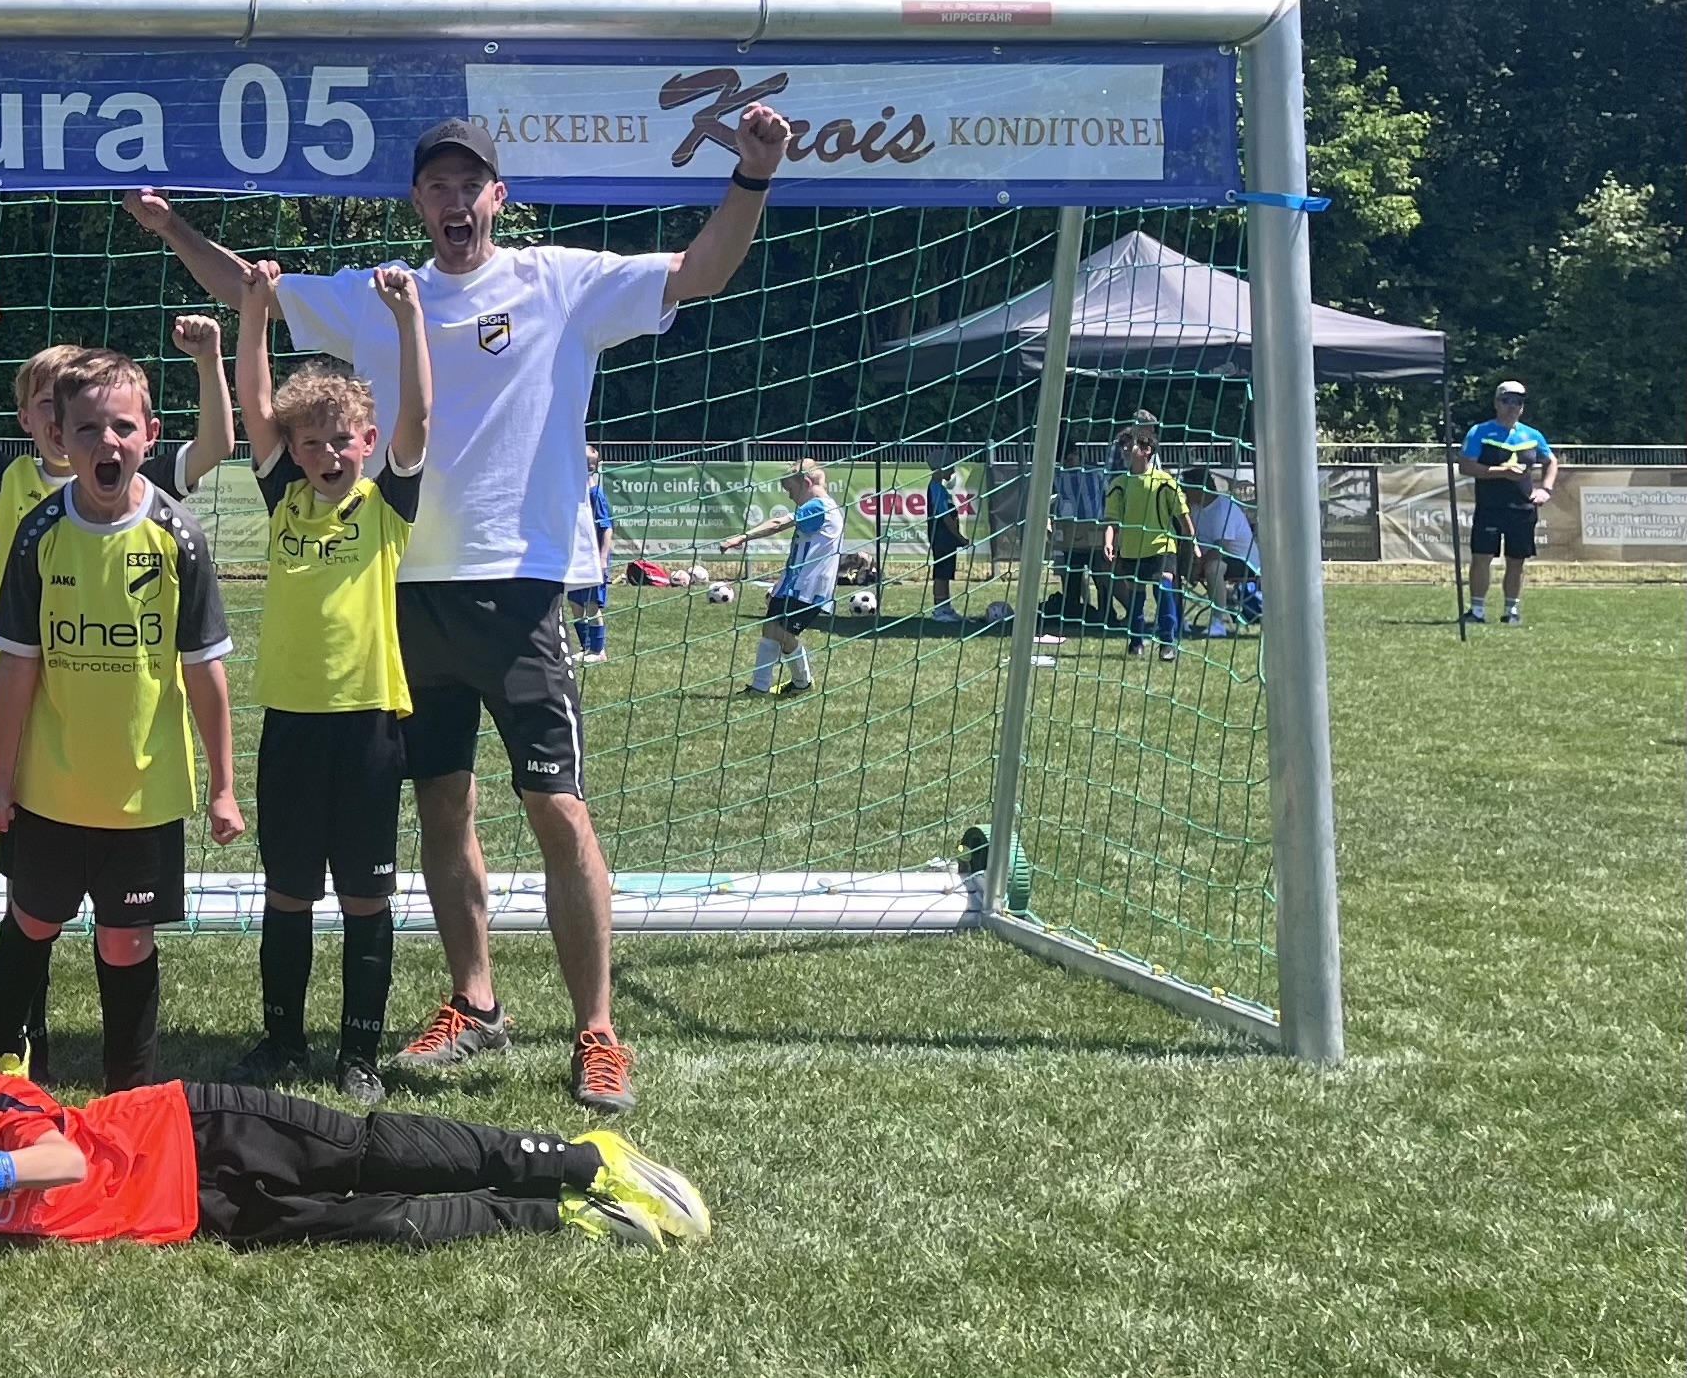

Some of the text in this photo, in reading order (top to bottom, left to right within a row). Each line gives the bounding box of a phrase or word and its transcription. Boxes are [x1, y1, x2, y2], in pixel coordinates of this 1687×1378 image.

[941, 13, 1012, 22] KIPPGEFAHR
[219, 63, 375, 176] 05
[948, 116, 1165, 147] KONDITOREI
[479, 315, 508, 325] SGH
[612, 478, 658, 494] Strom
[663, 477, 721, 494] einfach
[859, 492, 976, 515] enex
[128, 554, 160, 566] SGH
[50, 575, 76, 587] JAKO
[47, 611, 163, 651] joheß
[124, 892, 155, 904] JAKO
[345, 1016, 381, 1032] JAKO
